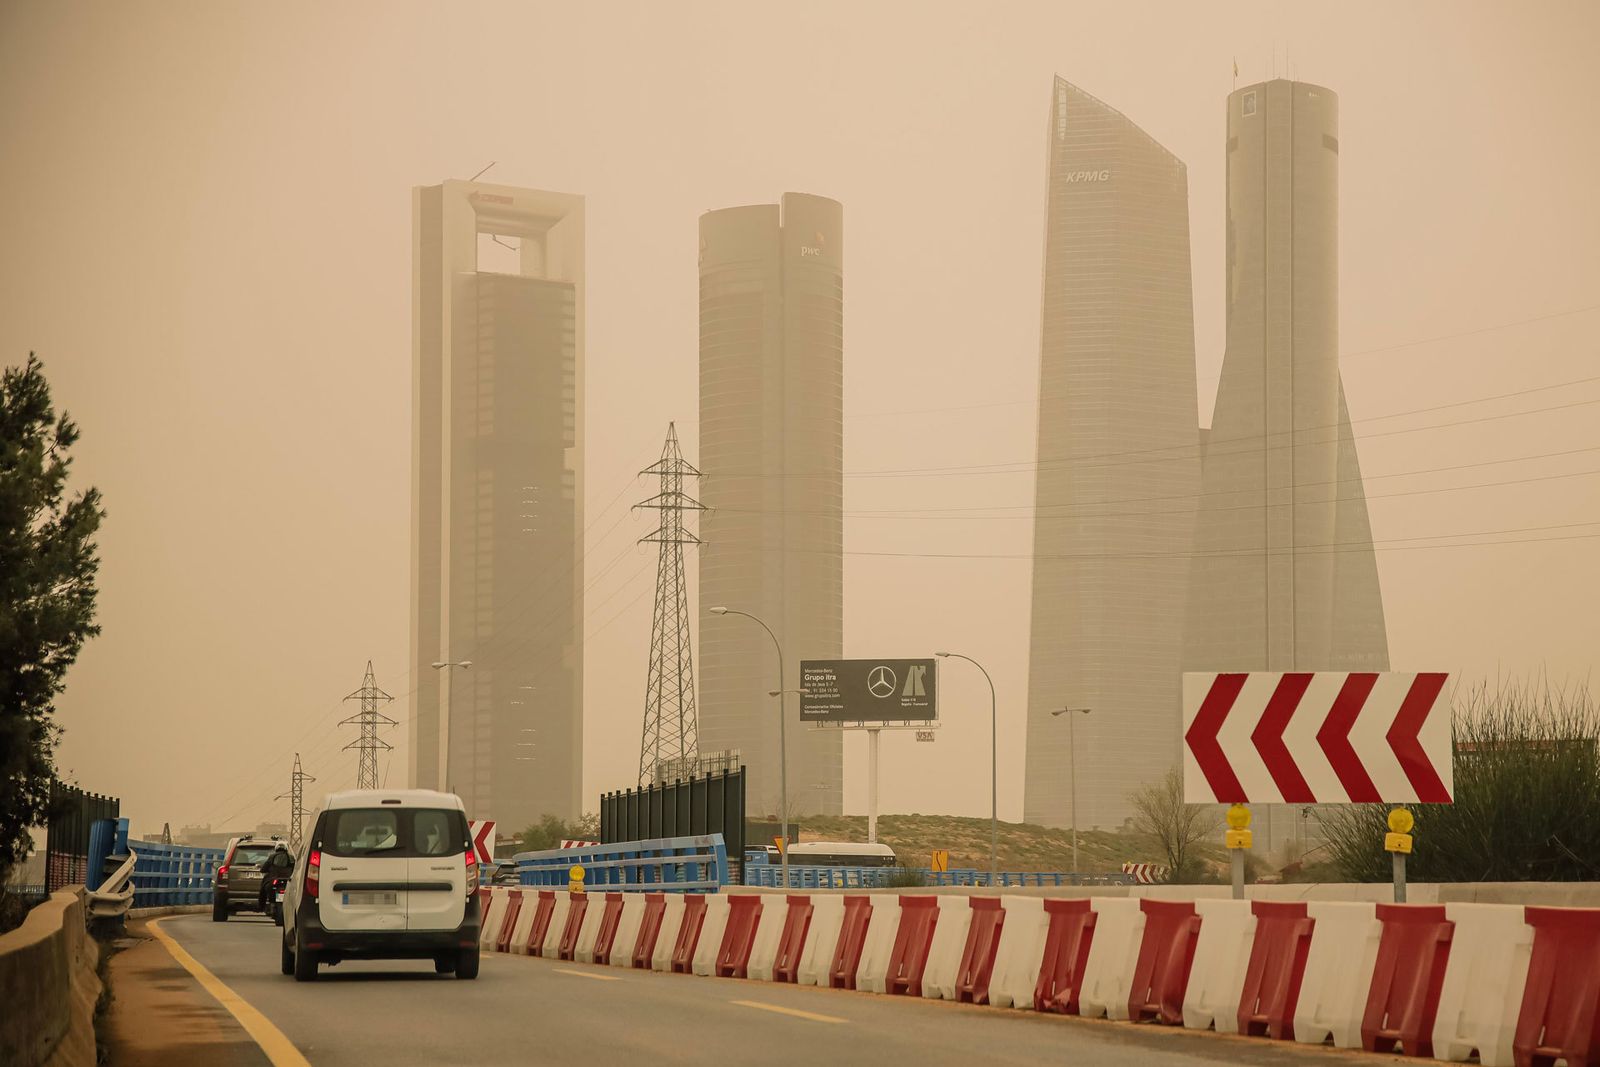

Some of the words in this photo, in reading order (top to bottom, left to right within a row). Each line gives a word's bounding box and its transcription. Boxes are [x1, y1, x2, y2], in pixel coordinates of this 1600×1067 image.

[1066, 169, 1110, 182] KPMG
[801, 246, 820, 257] pwc
[804, 673, 825, 682] Grupo
